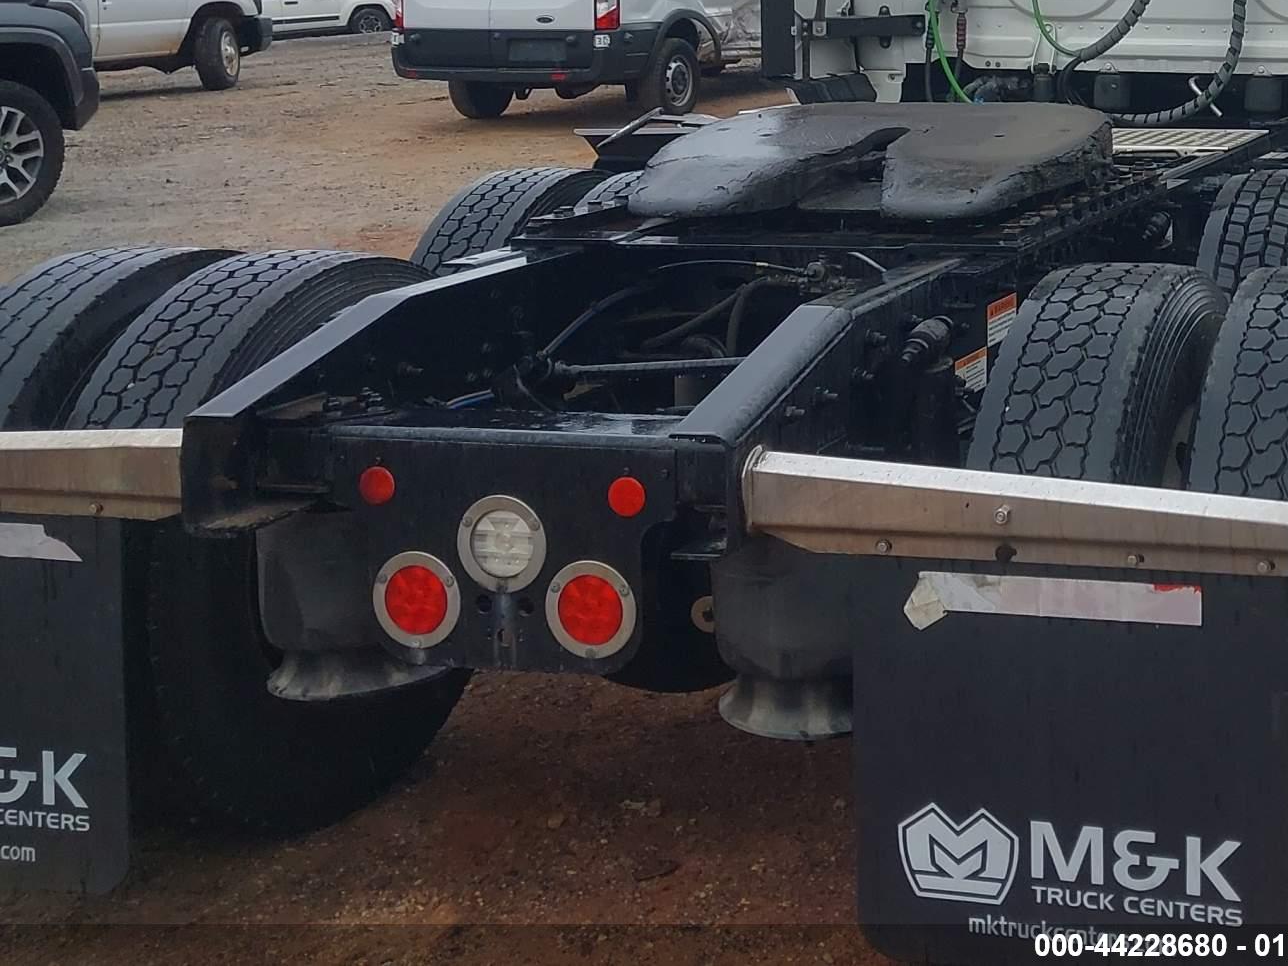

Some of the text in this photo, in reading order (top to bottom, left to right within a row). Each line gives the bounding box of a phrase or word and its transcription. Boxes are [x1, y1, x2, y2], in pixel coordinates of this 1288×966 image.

[1030, 820, 1242, 902] M&K
[1031, 885, 1243, 927] TRUCK CENTERS
